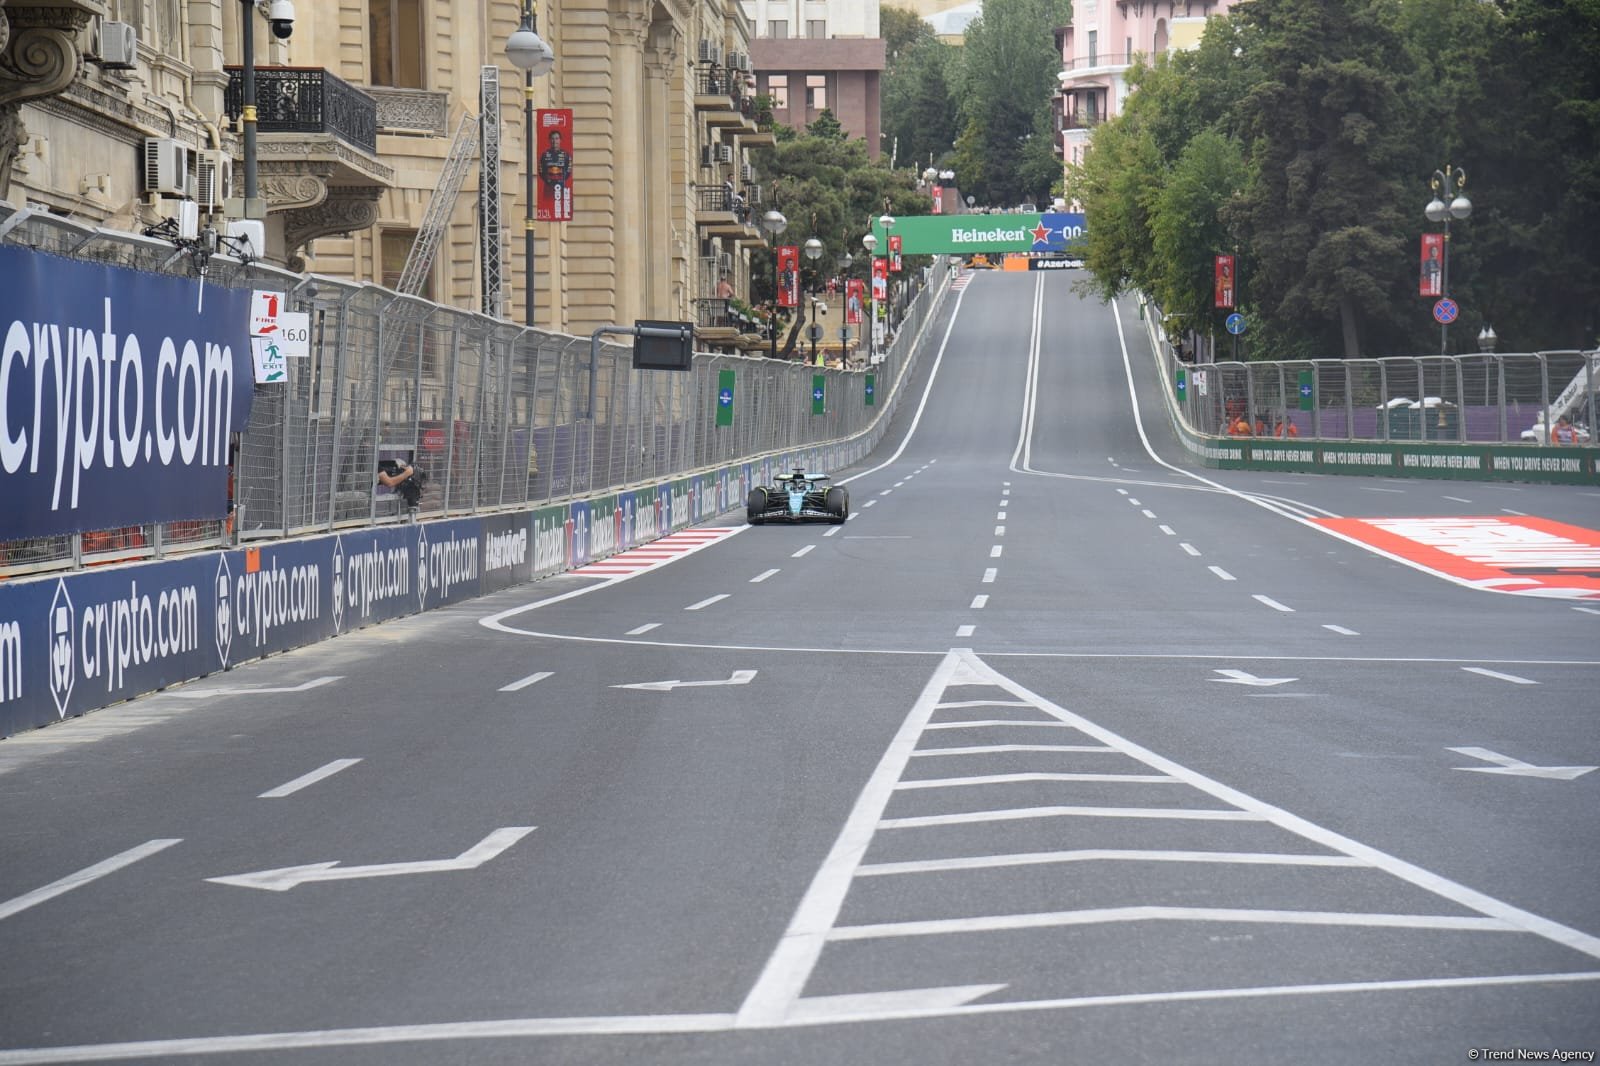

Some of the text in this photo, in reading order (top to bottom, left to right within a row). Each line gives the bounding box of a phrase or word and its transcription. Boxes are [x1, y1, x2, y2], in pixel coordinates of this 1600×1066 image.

[952, 228, 1025, 242] Heineken
[0, 297, 233, 510] crypto.com
[1323, 452, 1392, 465] WHEN YOU DRIVE NEVER DRINK
[1404, 454, 1480, 469] WHEN YOU DRIVE NEVER DRINK
[1494, 456, 1580, 472] WHEN YOU DRIVE NEVER DRINK
[430, 530, 478, 598] crypto.com
[535, 516, 564, 572] Heineken
[237, 555, 319, 647] crypto.com
[348, 540, 408, 618] crypto.com
[82, 580, 198, 692] crypto.com
